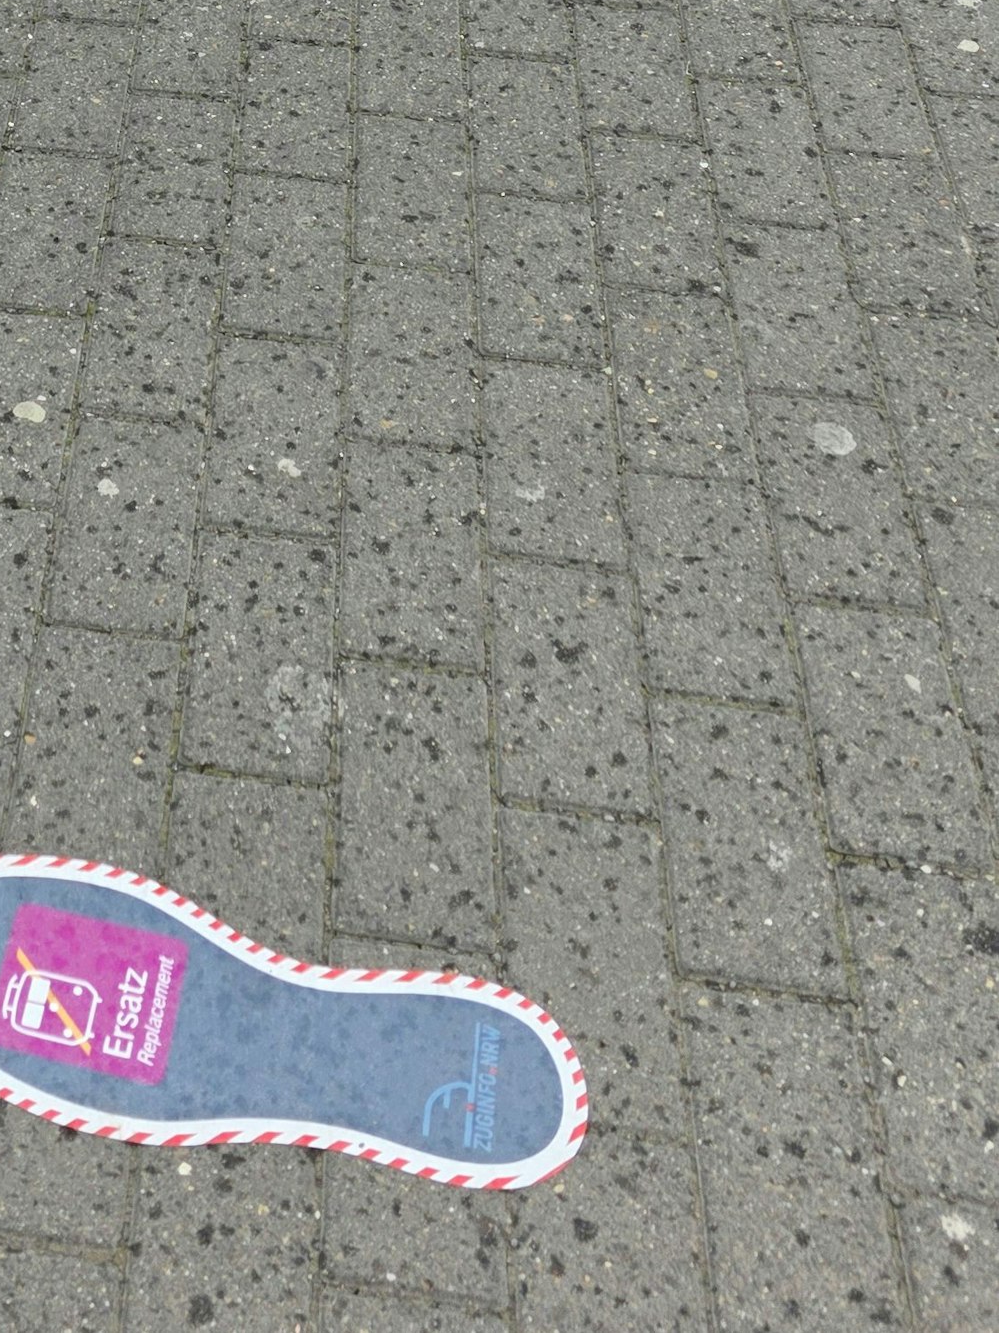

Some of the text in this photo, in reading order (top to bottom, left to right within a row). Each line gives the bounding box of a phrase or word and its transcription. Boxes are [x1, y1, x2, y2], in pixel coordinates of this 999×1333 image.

[102, 966, 148, 1059] Ersatz
[136, 954, 174, 1067] Replacement
[472, 1023, 501, 1152] ZUGINFO.NRW
